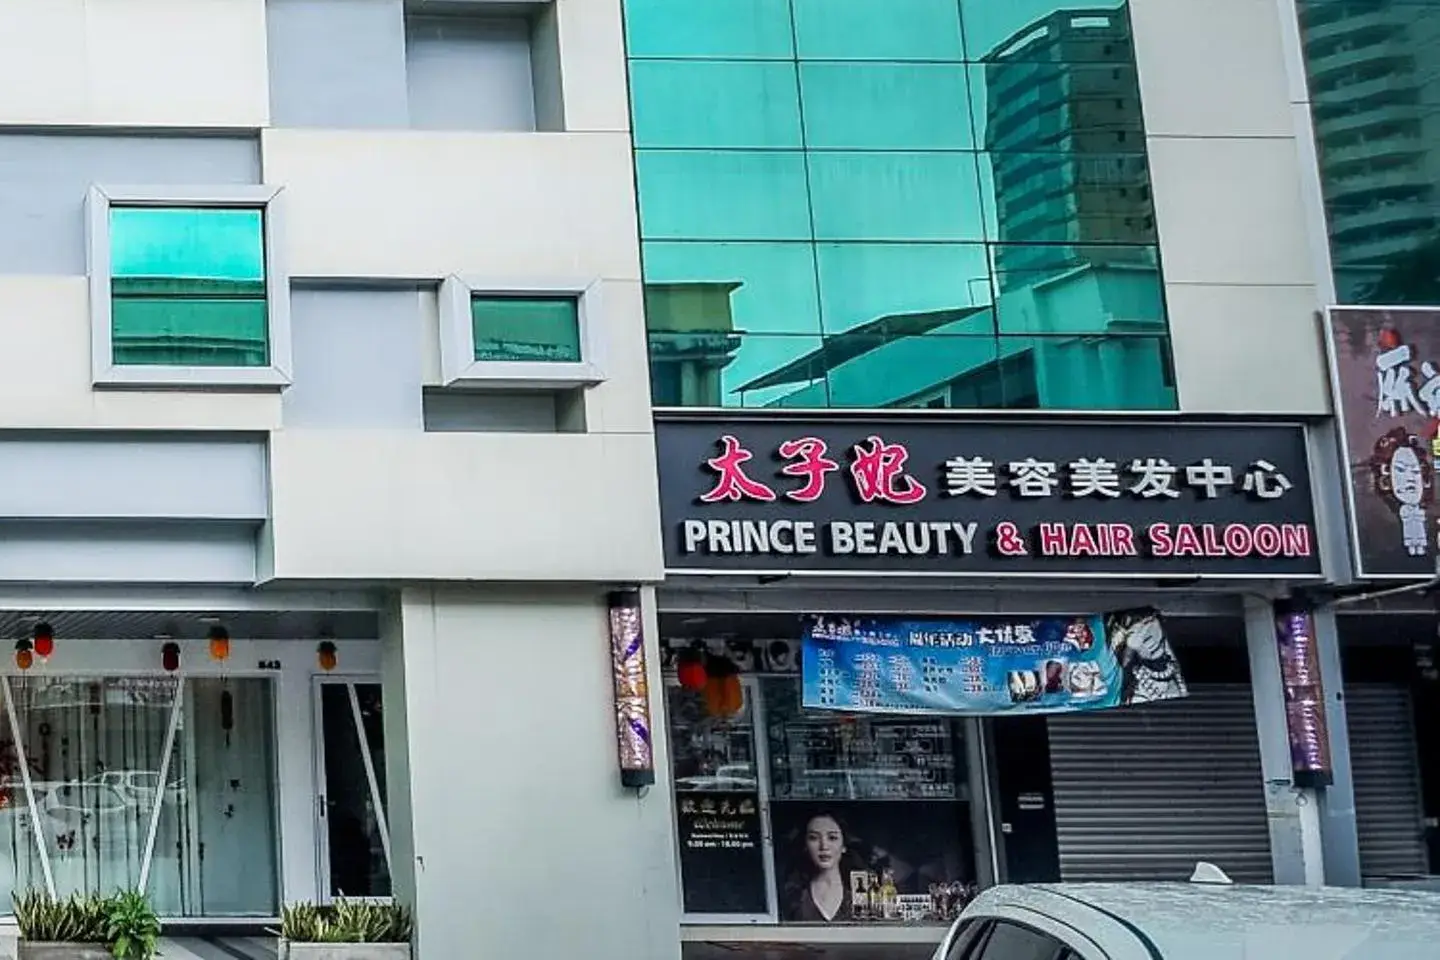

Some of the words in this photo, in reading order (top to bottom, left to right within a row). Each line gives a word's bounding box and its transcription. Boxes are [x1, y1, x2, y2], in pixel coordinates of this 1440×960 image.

[700, 435, 927, 504] 太子妃
[945, 456, 1293, 499] 美容美发中心
[684, 520, 817, 554] PRINCE
[831, 522, 978, 554] BEAUTY
[996, 522, 1027, 555] &
[1040, 523, 1137, 556] HAIR
[1149, 523, 1310, 557] SALOON
